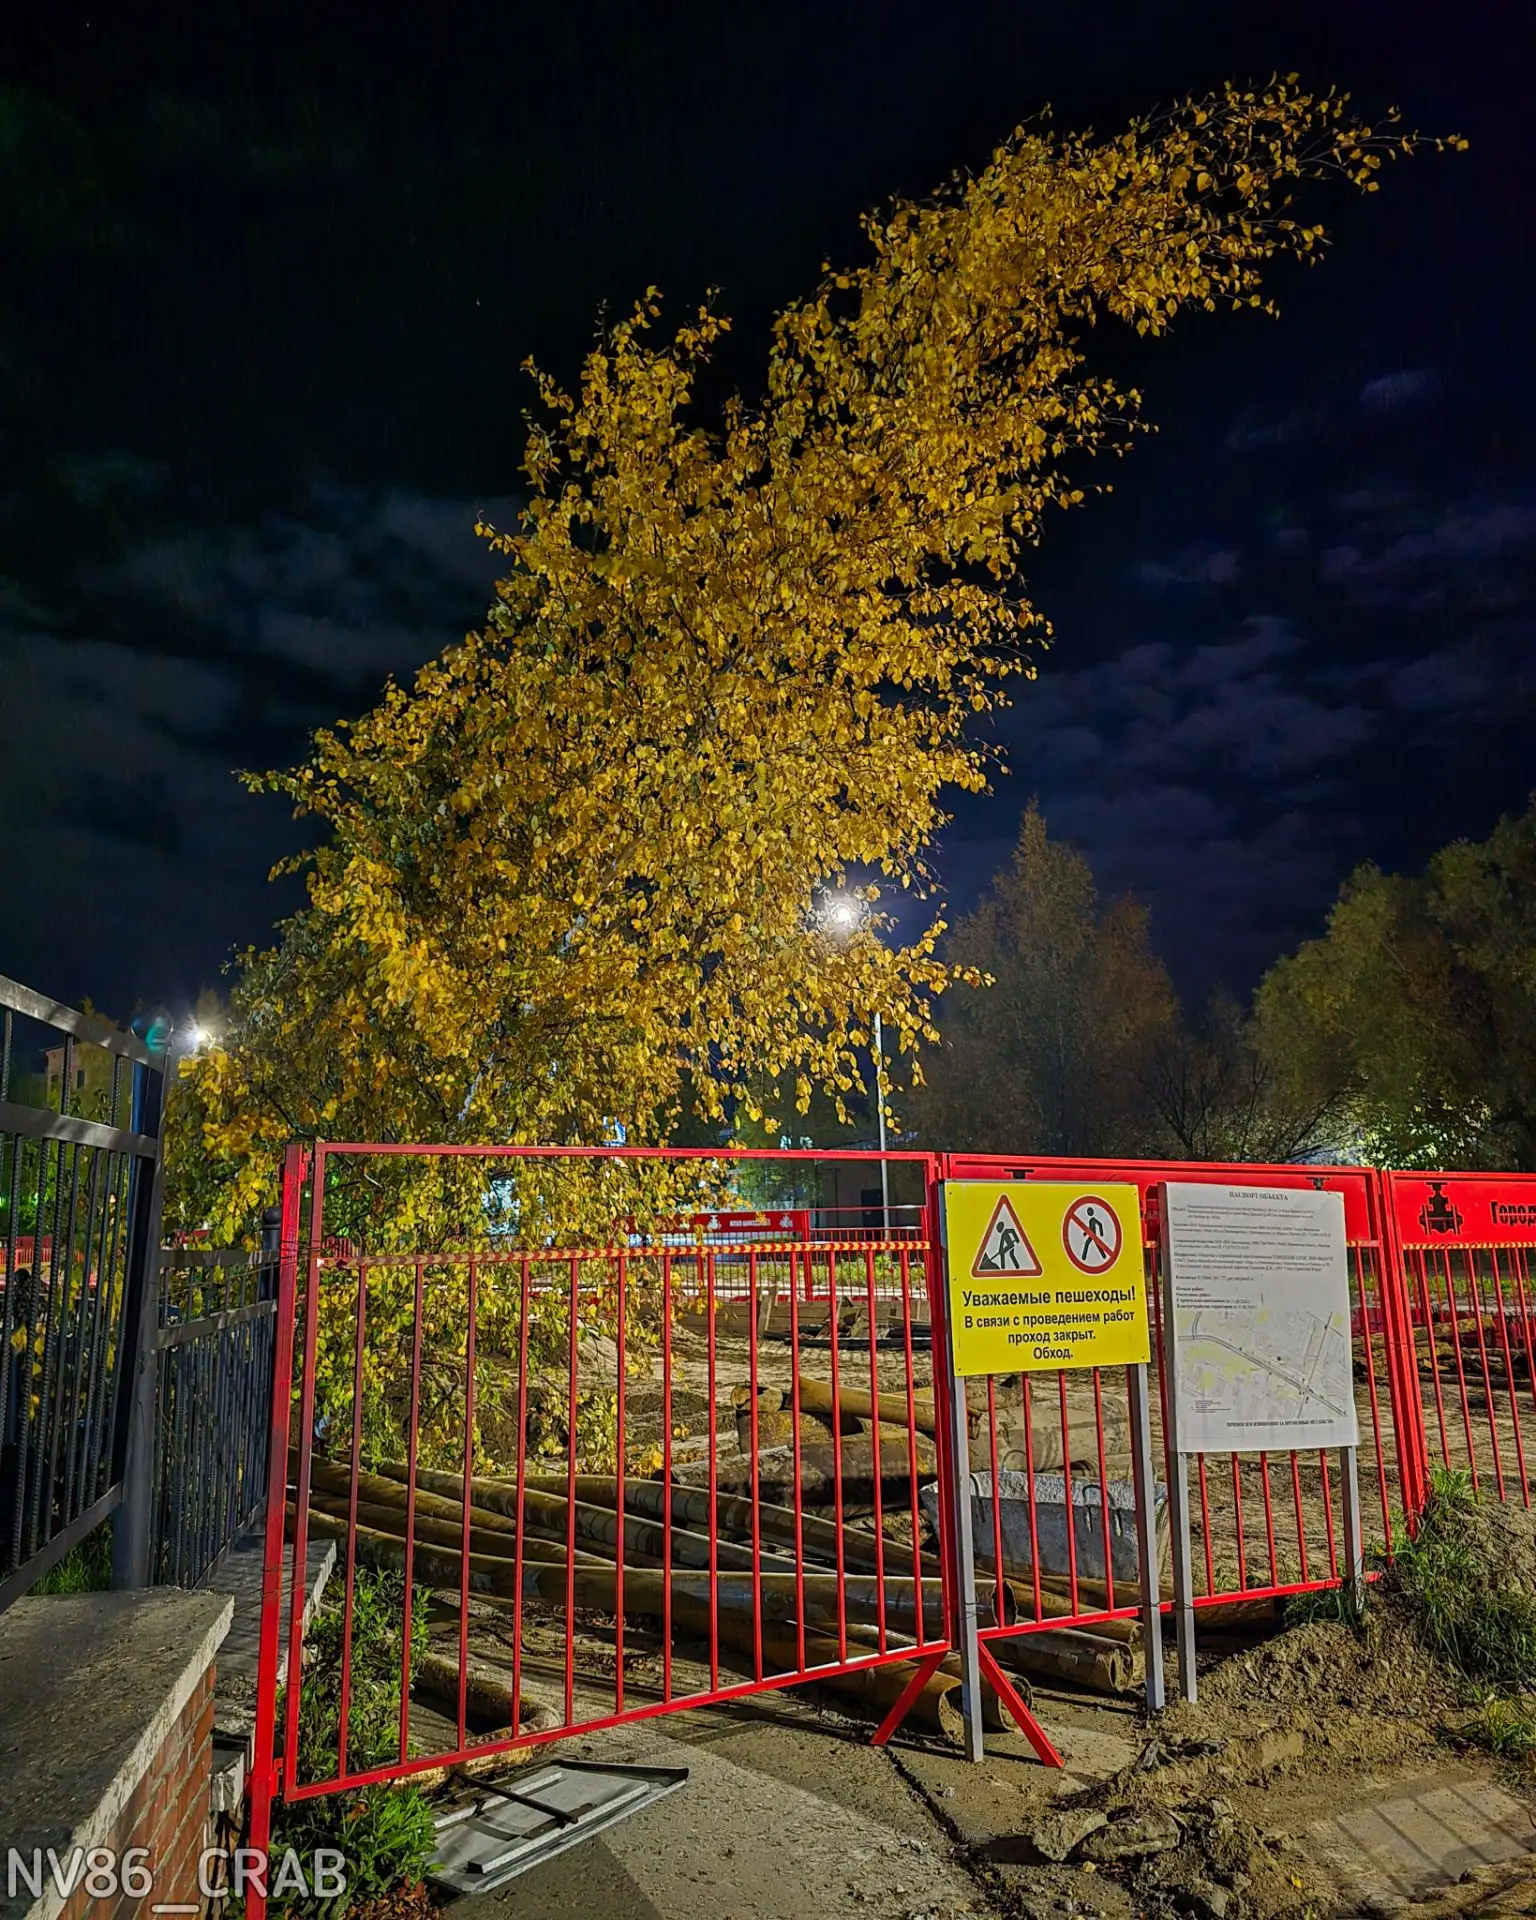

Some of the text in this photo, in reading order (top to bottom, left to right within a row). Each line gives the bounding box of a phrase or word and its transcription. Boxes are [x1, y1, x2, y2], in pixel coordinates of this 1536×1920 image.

[1259, 1192, 1289, 1201] ОБЪЕКТА
[962, 1285, 1136, 1307] Уважаемые пешеходы!
[965, 1309, 1135, 1328] В связи с проведением работ
[1008, 1329, 1096, 1346] проход закрыт.
[1033, 1346, 1074, 1360] Обход.
